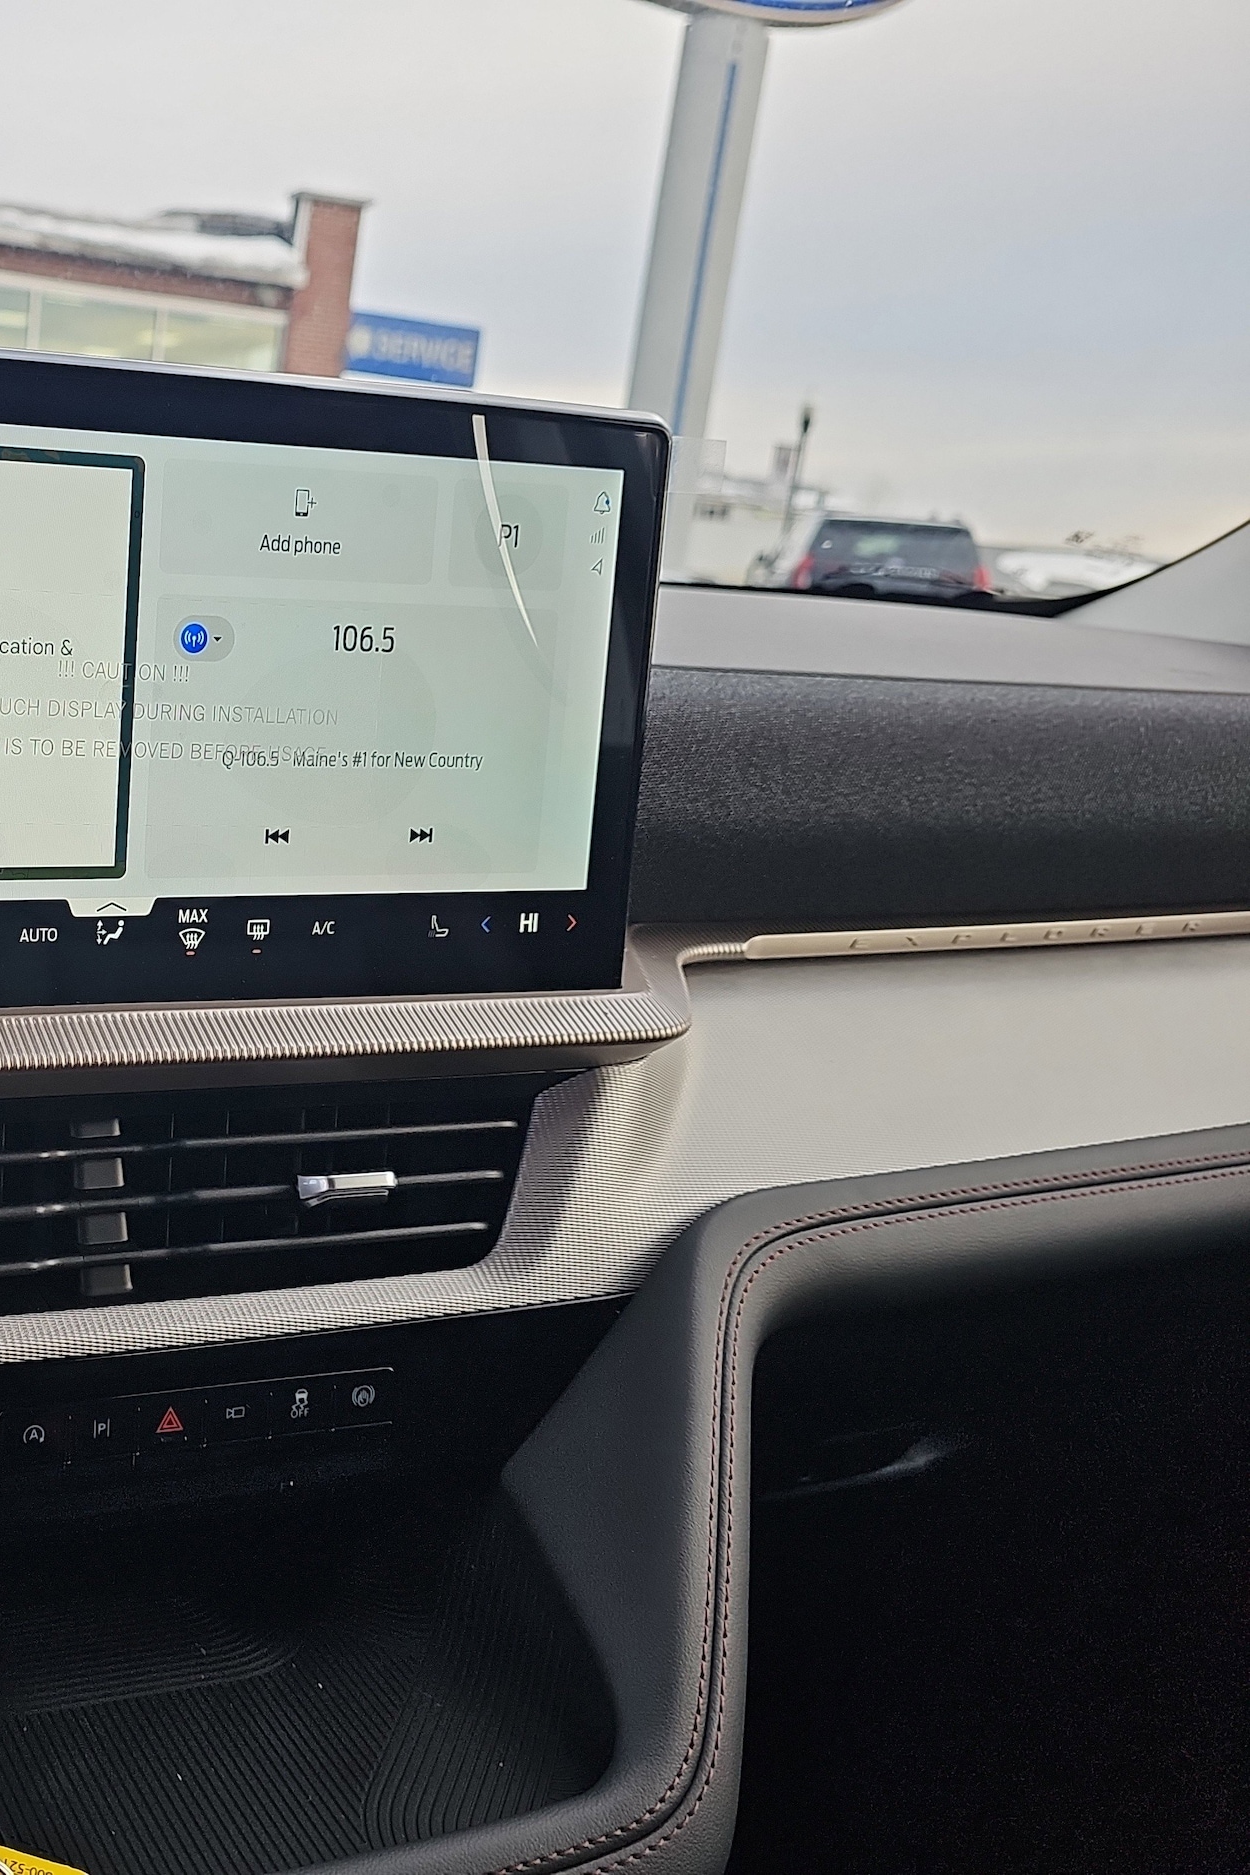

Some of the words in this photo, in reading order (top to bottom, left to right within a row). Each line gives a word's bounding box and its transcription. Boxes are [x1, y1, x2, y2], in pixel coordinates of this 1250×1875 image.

[376, 328, 474, 374] SERVICE
[259, 533, 291, 552] Add
[294, 536, 342, 556] phone
[60, 639, 74, 656] &
[332, 624, 396, 653] 106.5
[82, 661, 166, 681] CAUTON
[48, 699, 127, 719] DISPLAY
[133, 703, 205, 722] DURING
[212, 705, 339, 726] INSTALLATION
[5, 738, 23, 755] IS
[30, 738, 54, 757] TO
[62, 739, 86, 757] BE
[93, 740, 183, 760] REMOVED
[190, 743, 261, 762] BEFORE
[222, 750, 279, 770] Q-106.5
[293, 750, 348, 767] Maine's
[352, 751, 368, 767] #1
[371, 751, 391, 768] for
[394, 751, 426, 768] New
[429, 751, 483, 771] Country
[178, 908, 208, 924] MAX
[19, 927, 58, 943] AUTO
[311, 920, 336, 935] A/C
[519, 913, 539, 933] HI
[849, 920, 1200, 949] EXPLORER
[290, 1408, 310, 1419] OFF
